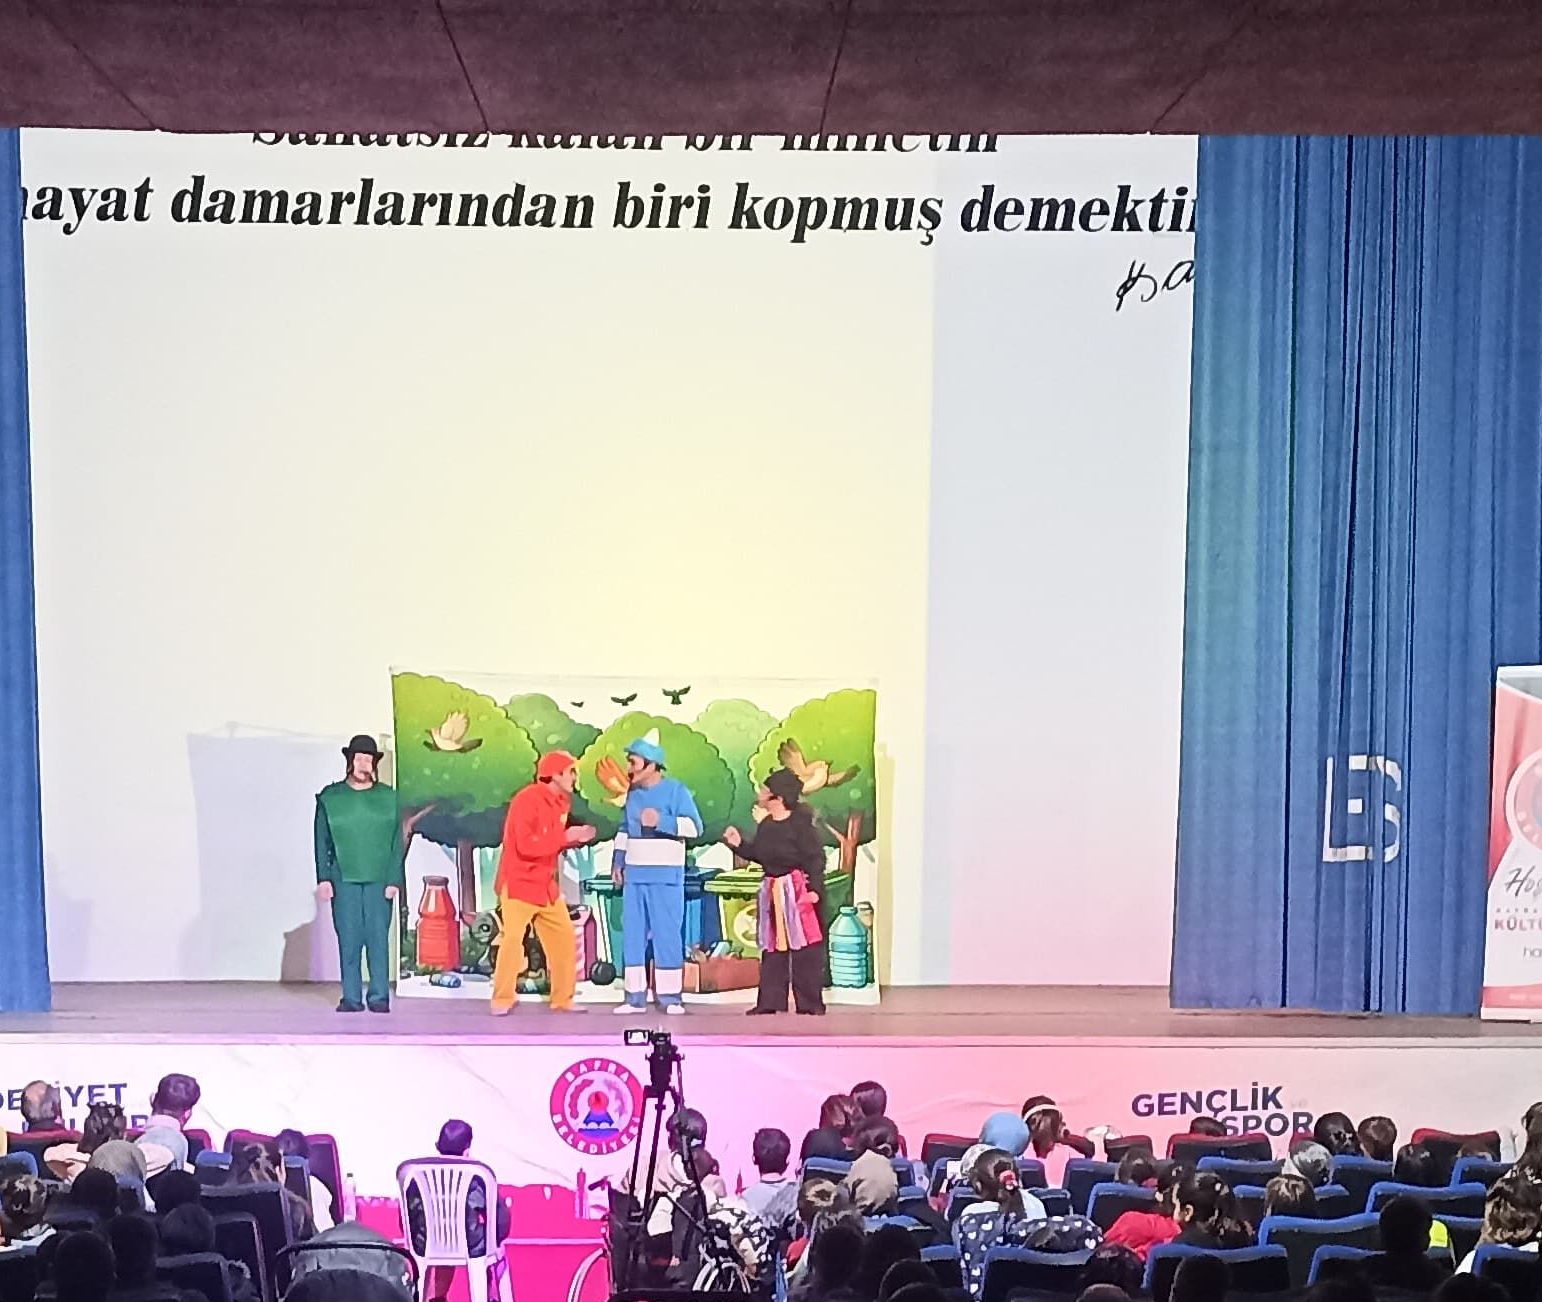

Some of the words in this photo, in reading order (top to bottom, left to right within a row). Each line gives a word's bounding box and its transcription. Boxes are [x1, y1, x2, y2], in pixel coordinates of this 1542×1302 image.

[171, 174, 595, 229] damarlarından
[612, 180, 711, 229] biri
[727, 181, 944, 247] kopmuş
[960, 184, 1196, 233] demekti
[564, 1060, 629, 1083] BAFRA
[1131, 1081, 1283, 1118] GENÇLİK
[1223, 1112, 1314, 1137] SPOR
